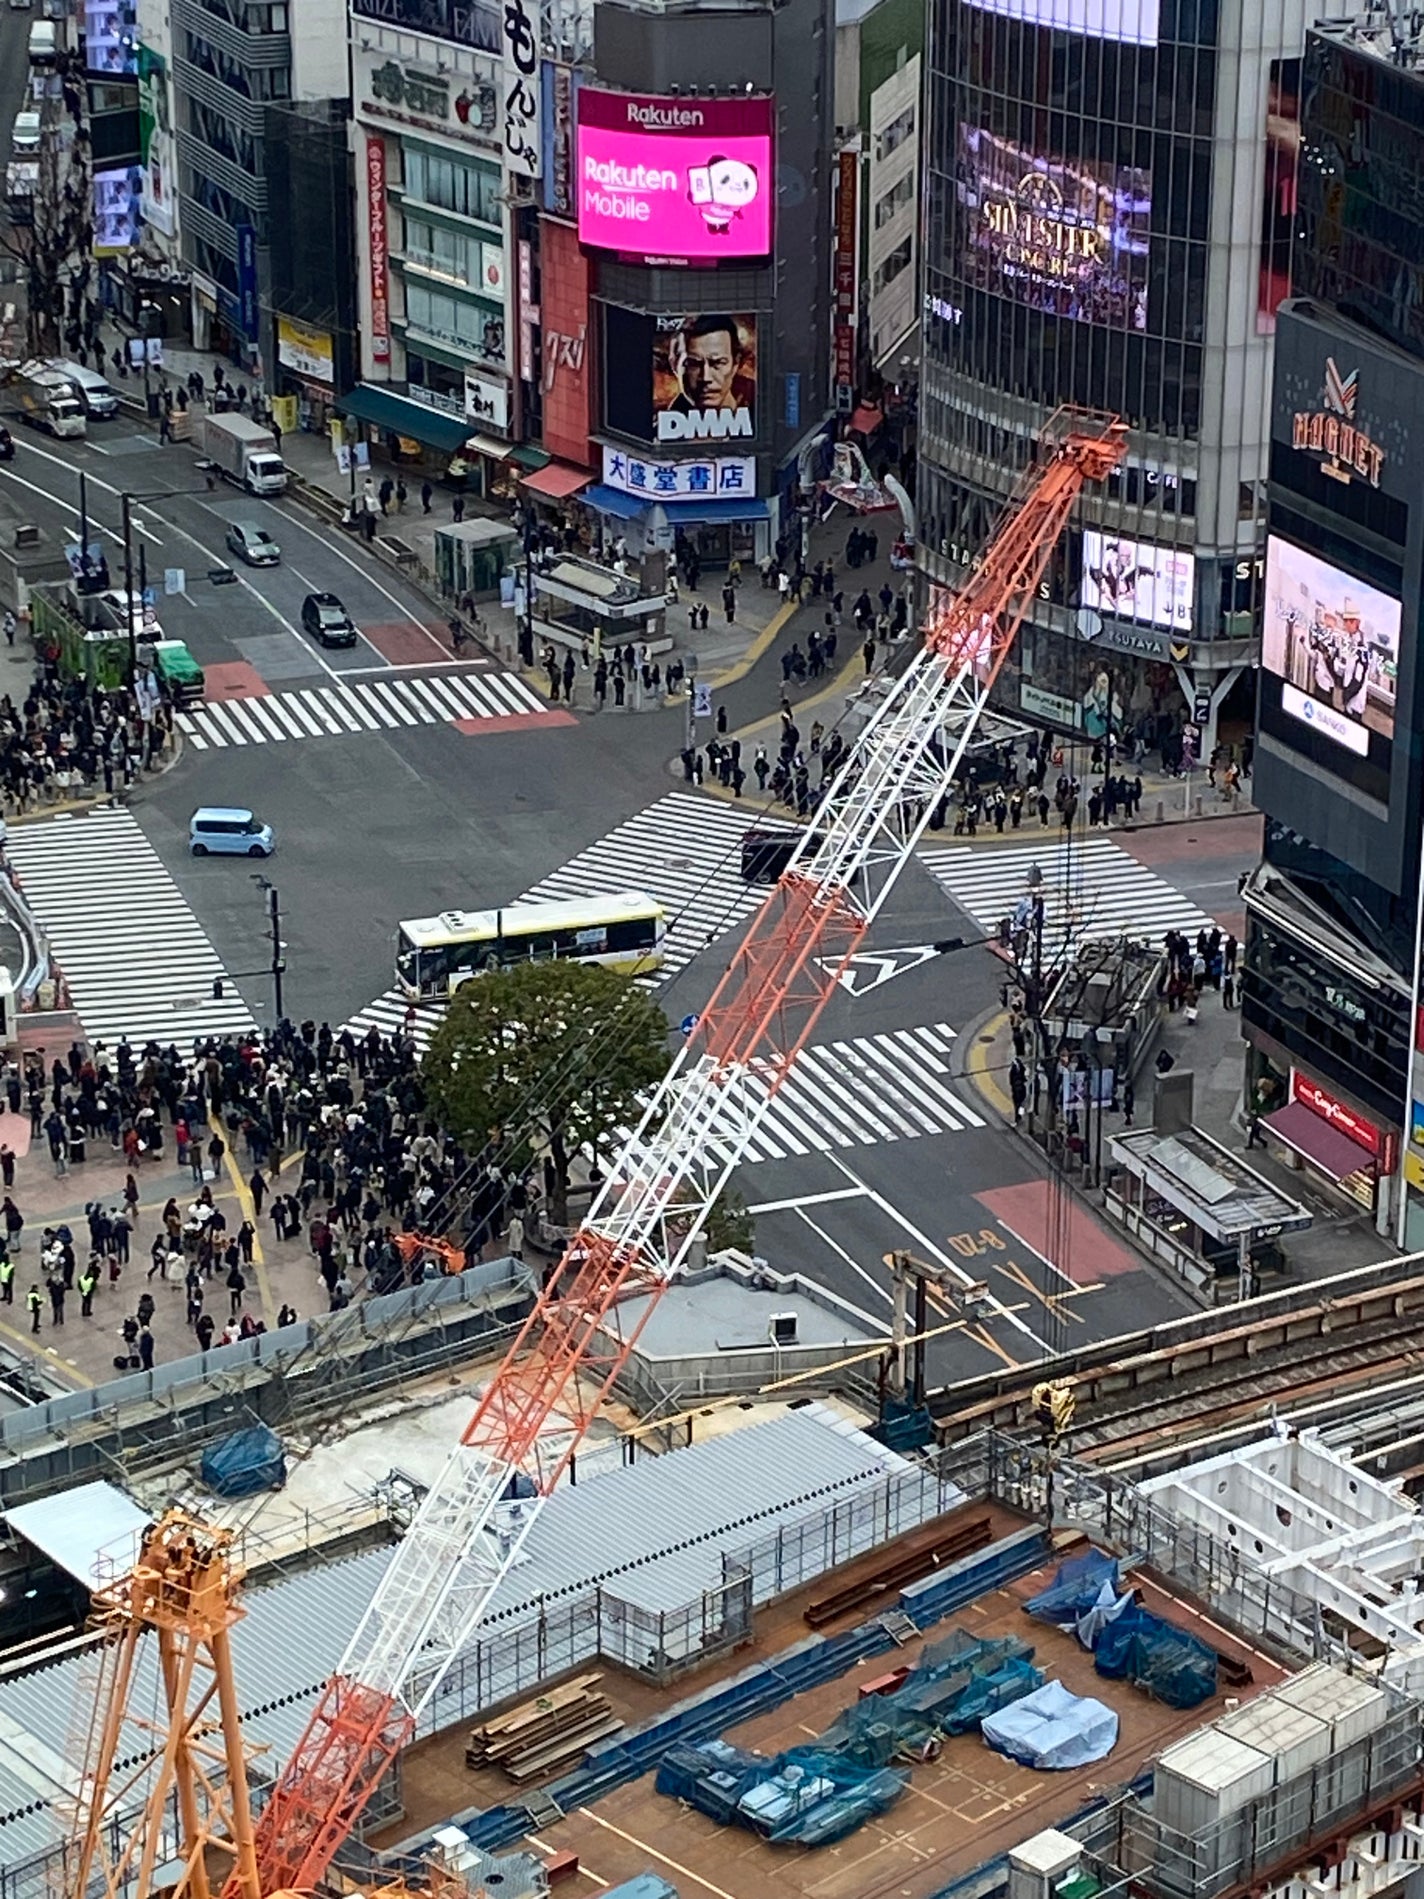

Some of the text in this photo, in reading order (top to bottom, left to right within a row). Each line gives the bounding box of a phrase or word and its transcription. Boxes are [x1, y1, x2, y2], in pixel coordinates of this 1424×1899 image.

[504, 0, 538, 173] もんじゃ
[627, 103, 704, 129] Rakuten
[585, 156, 677, 193] Rakuten
[585, 190, 650, 221] Mobile
[657, 407, 753, 441] DMM
[609, 454, 745, 492] 大盛堂書店
